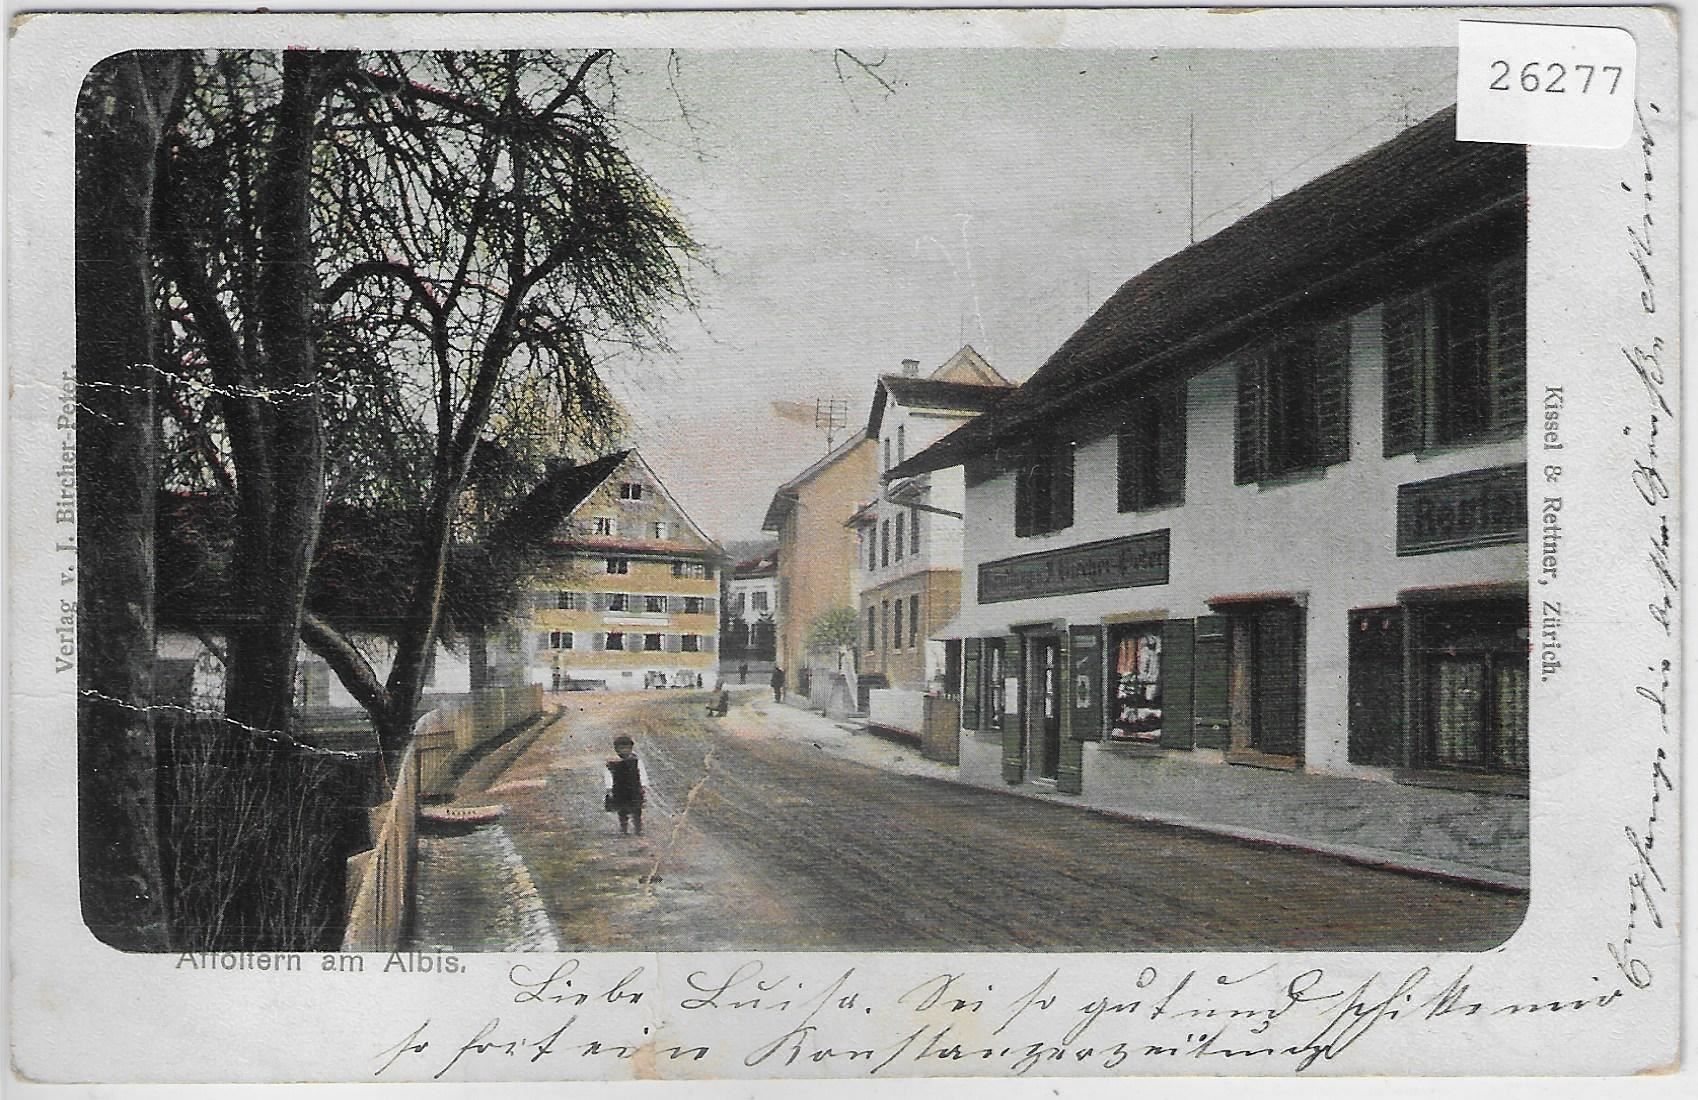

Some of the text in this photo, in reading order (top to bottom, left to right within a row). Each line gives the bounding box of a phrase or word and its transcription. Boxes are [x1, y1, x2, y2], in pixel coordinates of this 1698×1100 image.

[1489, 60, 1622, 95] 26277
[55, 536, 78, 555] J.
[1538, 386, 1564, 683] Kissel & Rettner, Zürich.
[60, 565, 75, 587] v.
[55, 599, 78, 674] Verlag
[175, 951, 466, 973] Affoltern am Albis.
[508, 958, 644, 1005] Liebe
